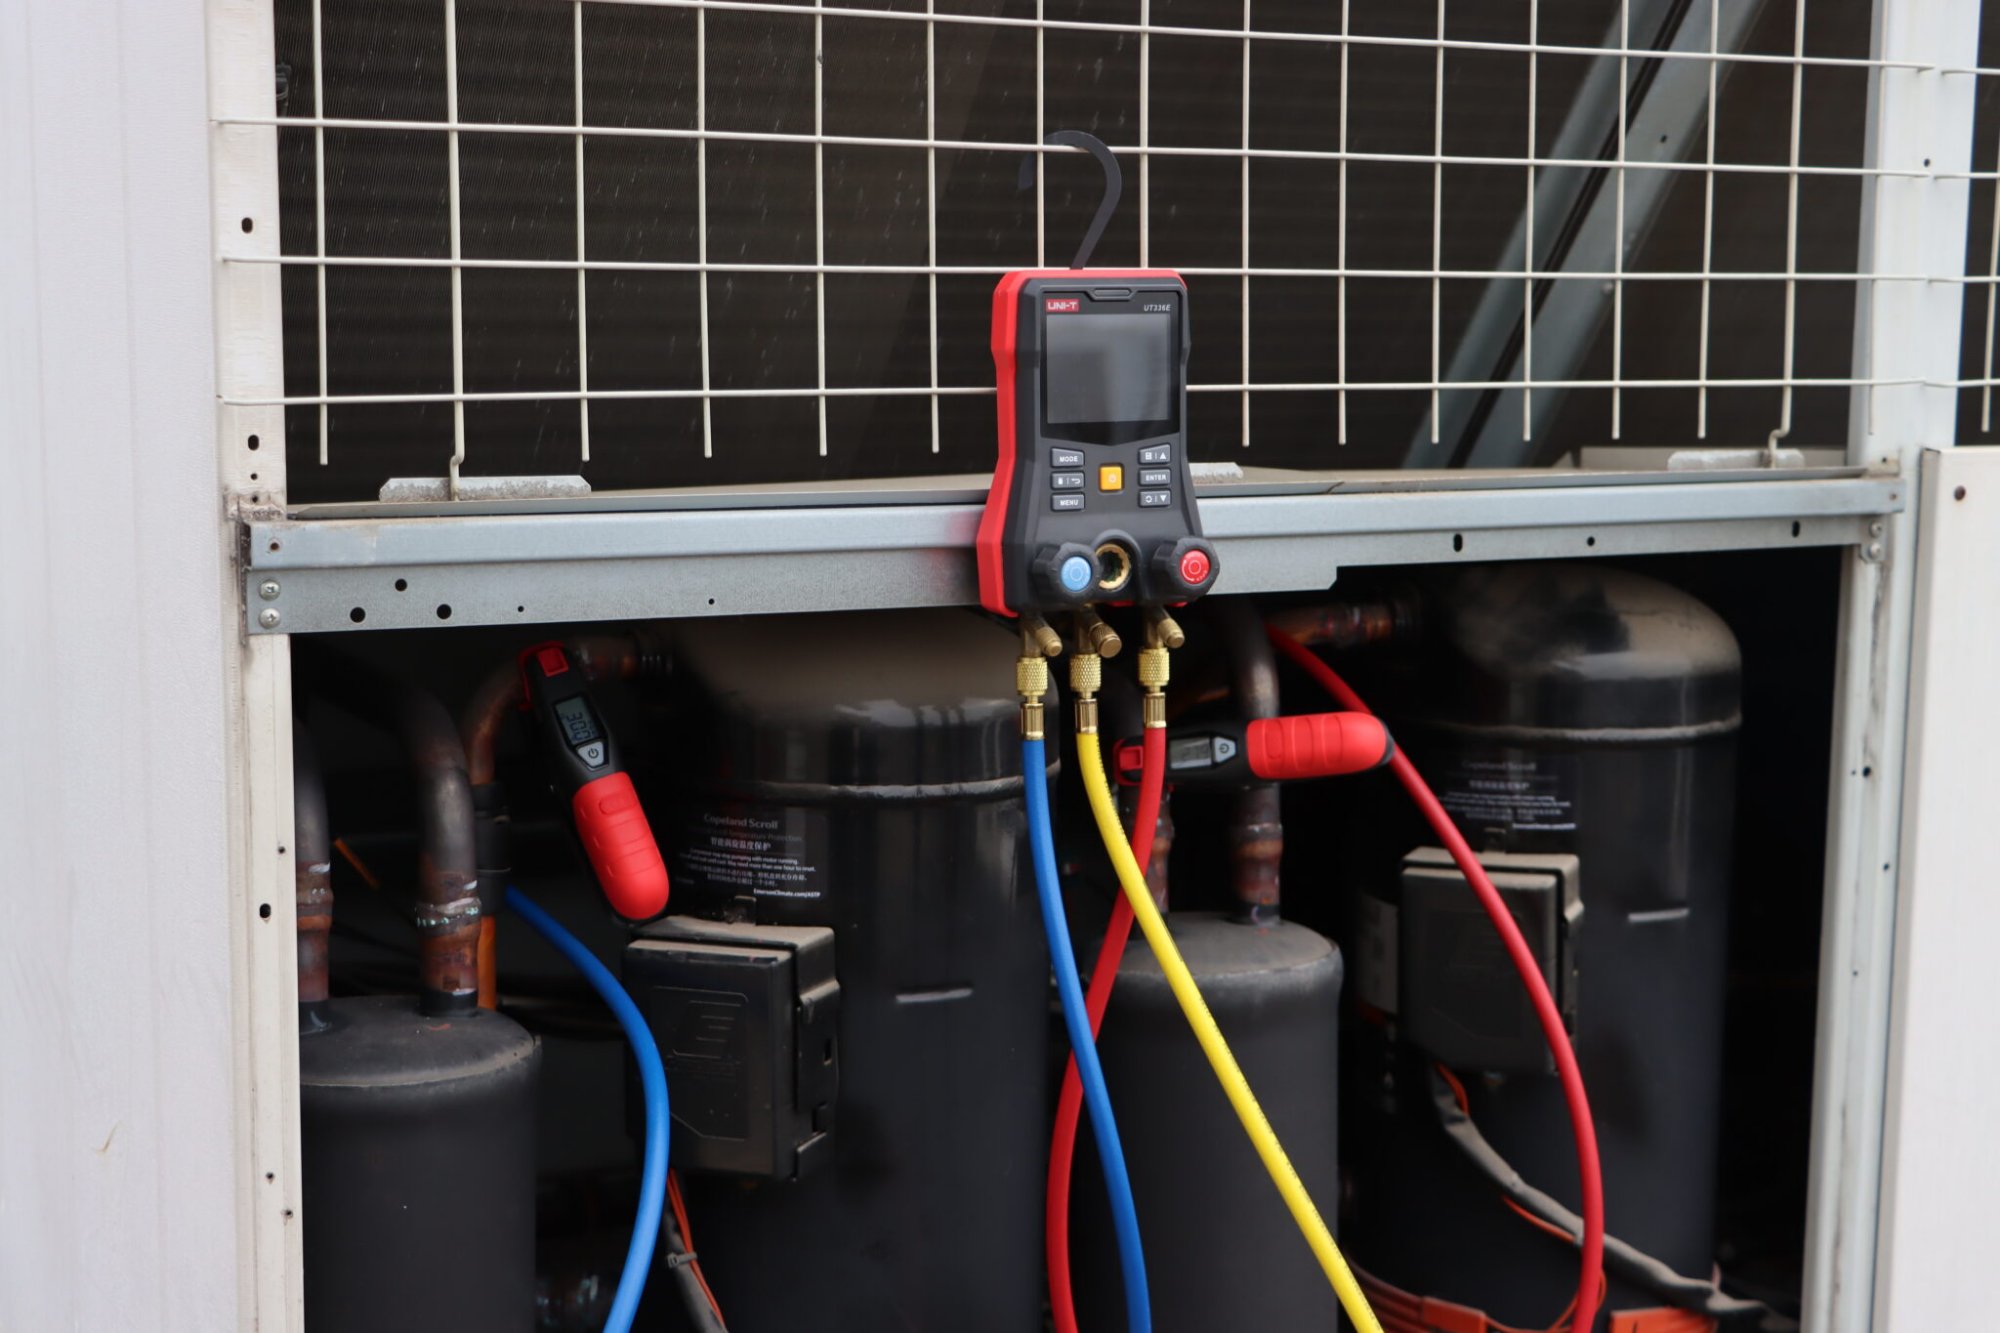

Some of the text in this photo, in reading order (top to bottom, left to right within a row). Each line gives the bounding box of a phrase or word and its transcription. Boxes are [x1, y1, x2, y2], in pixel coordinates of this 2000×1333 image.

[1047, 300, 1079, 310] UNI-T
[1143, 304, 1172, 312] UT336E
[1059, 455, 1079, 463] MODE
[704, 813, 779, 829] Copeland Scroll
